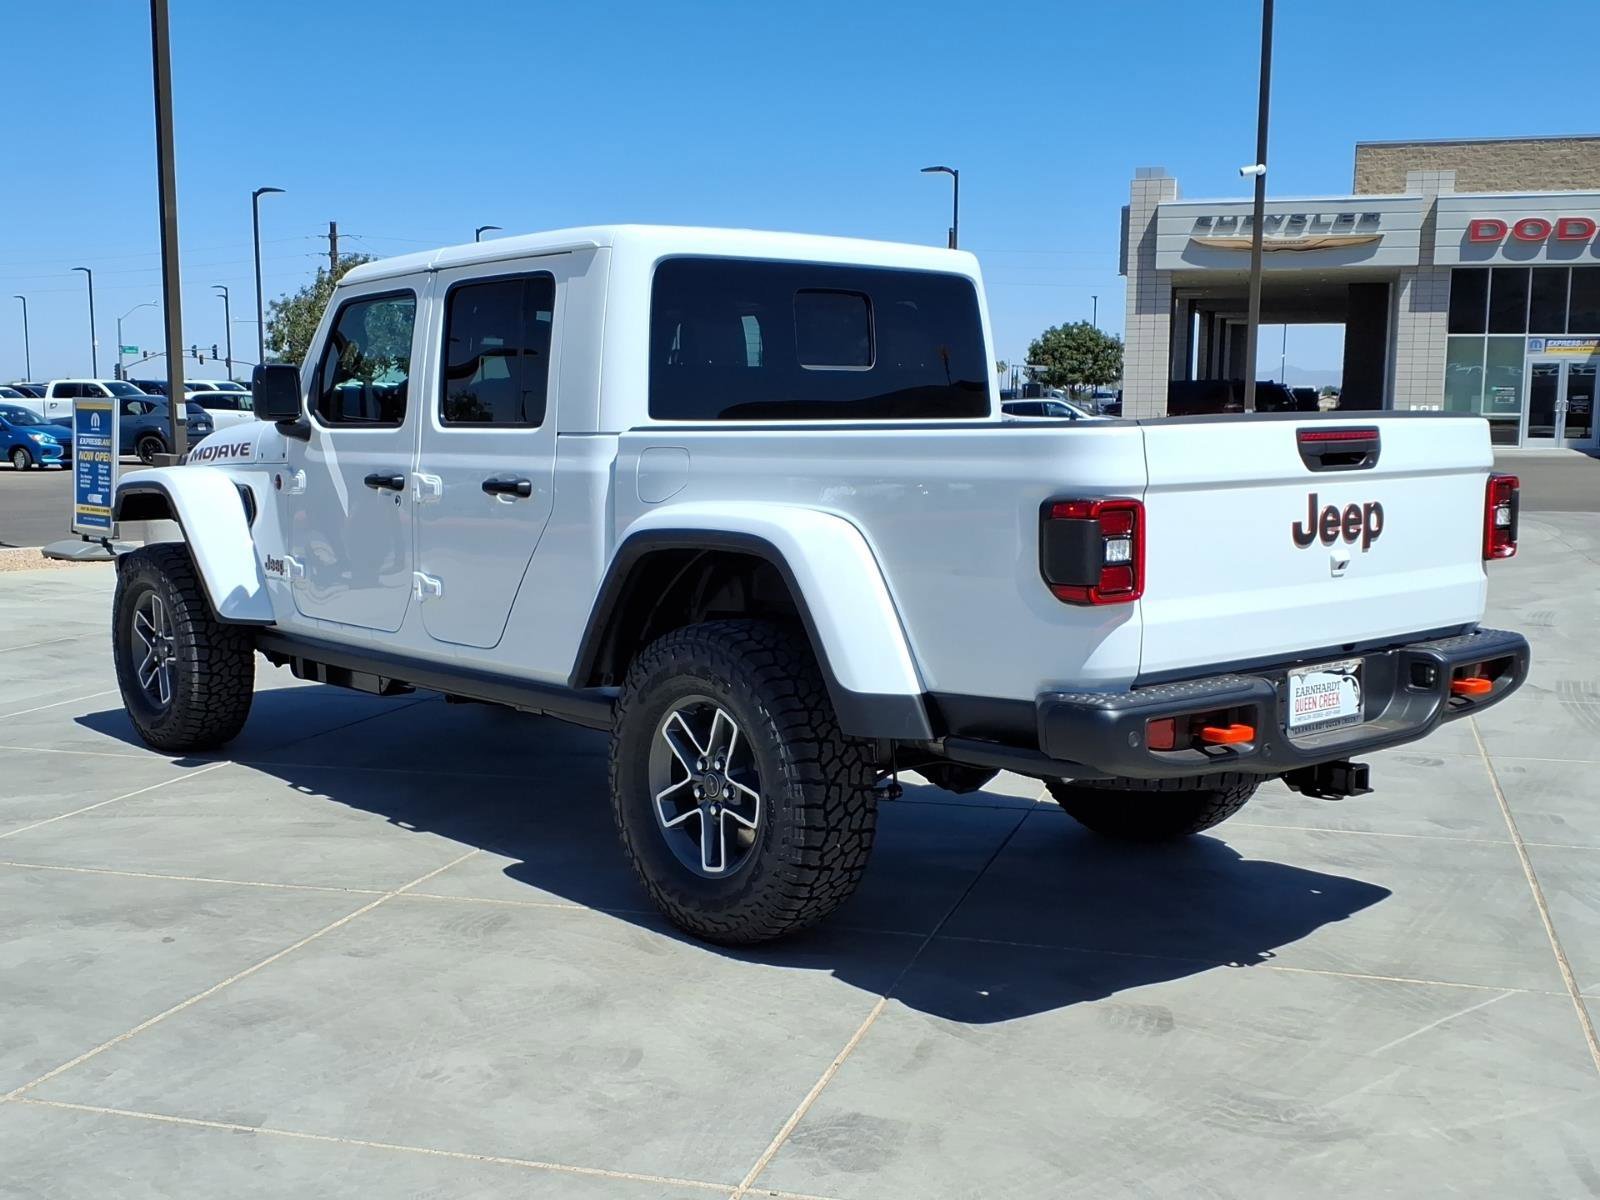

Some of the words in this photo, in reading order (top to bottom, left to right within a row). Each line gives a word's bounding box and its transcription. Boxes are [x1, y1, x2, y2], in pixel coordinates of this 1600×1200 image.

[79, 450, 93, 461] NOW
[190, 442, 251, 461] MOJAVE
[1292, 493, 1384, 551] Jeep
[265, 554, 284, 575] Jeep
[1296, 680, 1341, 698] EARNHARDT
[1295, 696, 1317, 713] QUEEN
[1319, 692, 1341, 707] CREEK
